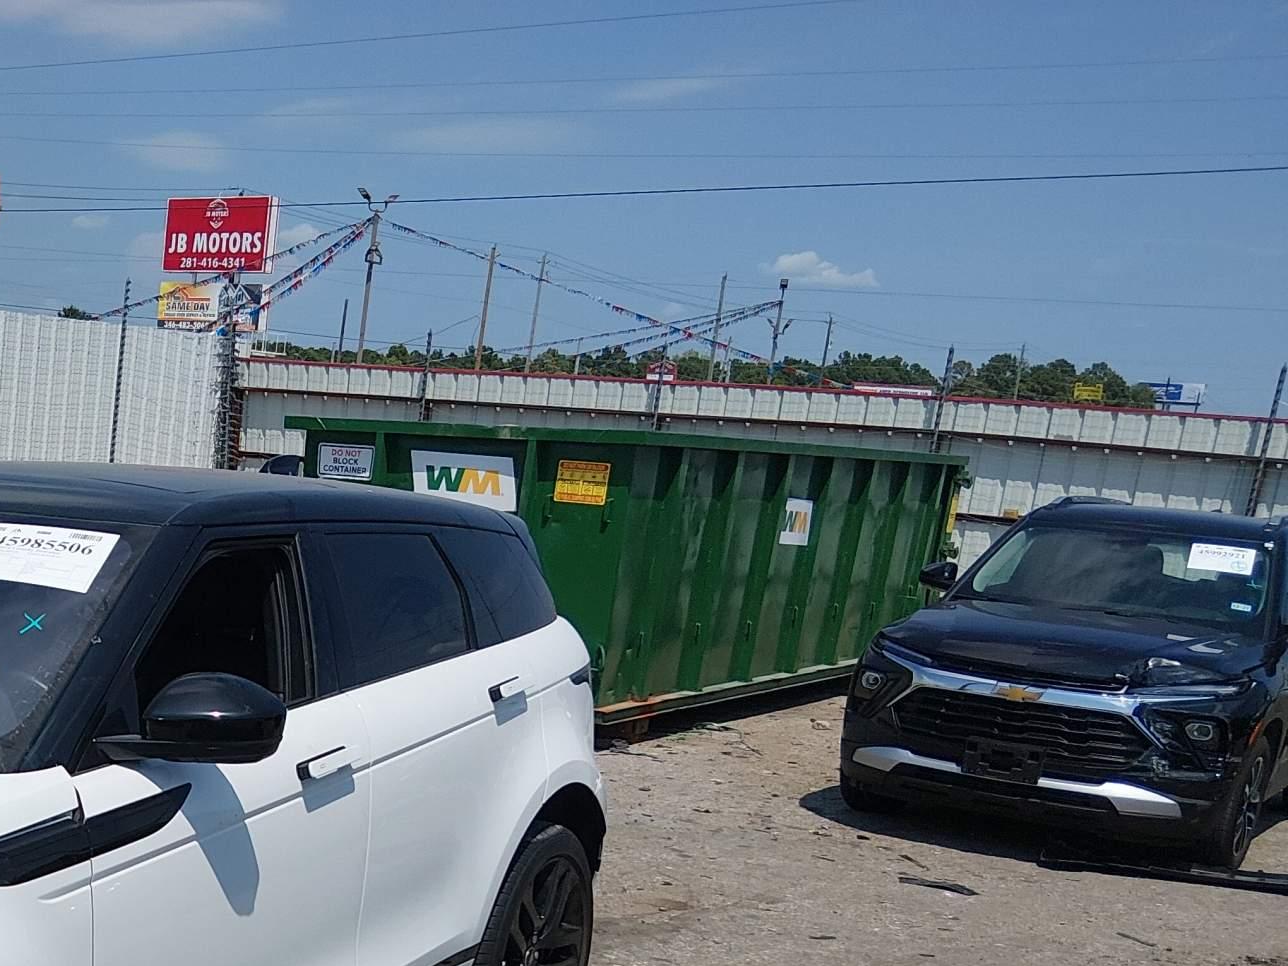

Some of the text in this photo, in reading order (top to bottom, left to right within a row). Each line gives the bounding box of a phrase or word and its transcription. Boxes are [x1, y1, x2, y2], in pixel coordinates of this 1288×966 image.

[168, 232, 262, 253] JB MOTORS
[180, 257, 246, 269] 281-416-4341
[166, 302, 210, 312] SAME DAY
[331, 448, 362, 457] DO NOT
[333, 456, 359, 465] BLOCK
[323, 464, 367, 475] CONTAINER
[425, 464, 503, 497] WM
